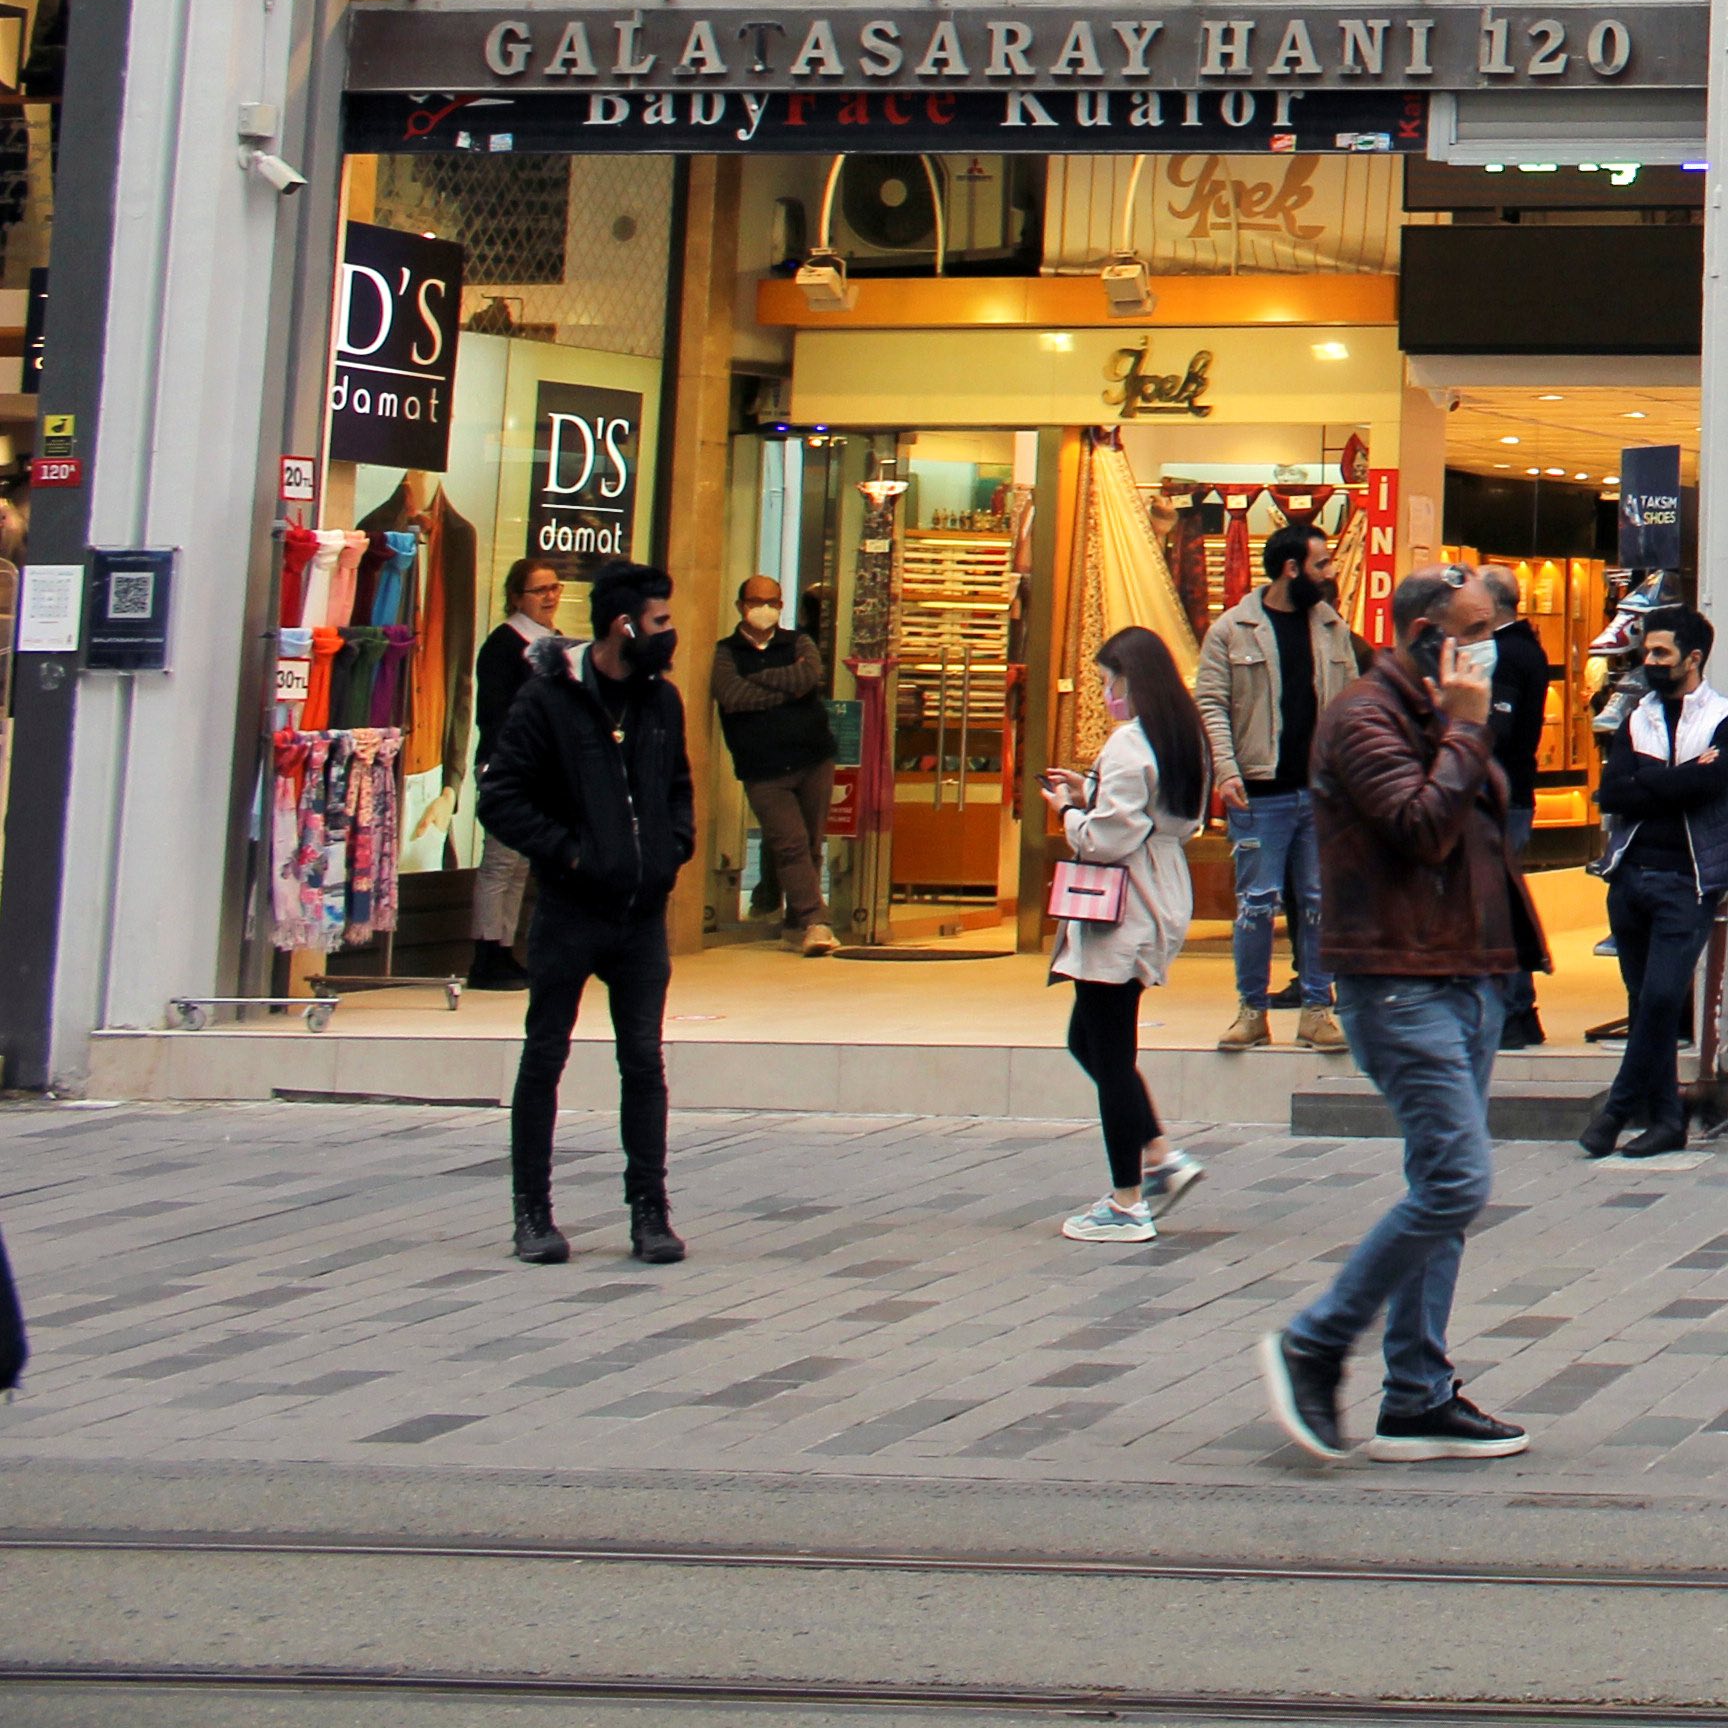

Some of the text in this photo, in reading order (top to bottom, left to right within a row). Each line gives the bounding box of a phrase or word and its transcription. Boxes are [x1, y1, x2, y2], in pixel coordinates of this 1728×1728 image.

[484, 17, 1633, 77] GALATASARAY HANI 120
[330, 375, 439, 424] damat
[542, 411, 630, 499] D'S
[539, 518, 623, 555] damat
[1643, 511, 1677, 526] SHOES
